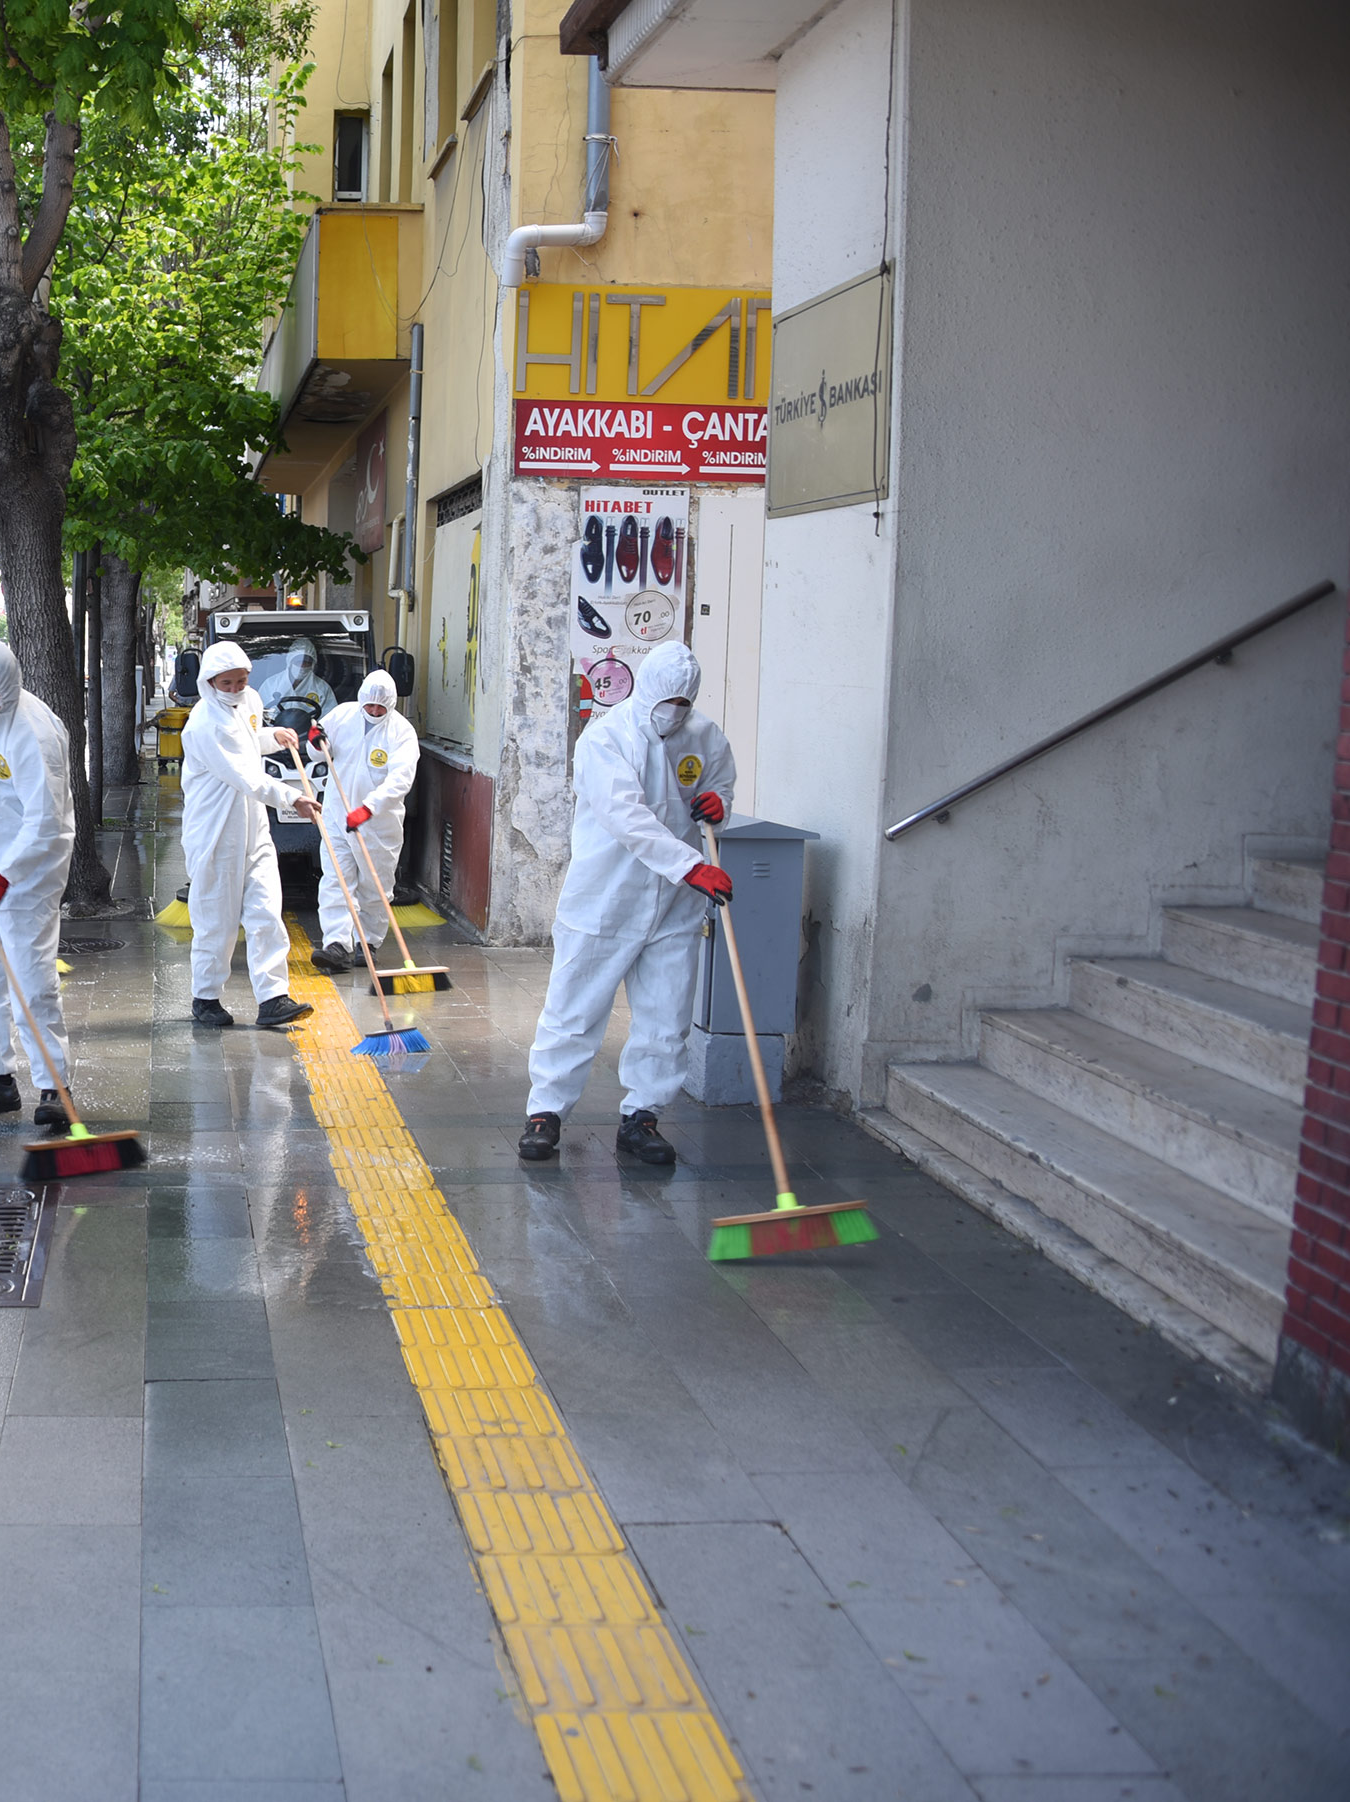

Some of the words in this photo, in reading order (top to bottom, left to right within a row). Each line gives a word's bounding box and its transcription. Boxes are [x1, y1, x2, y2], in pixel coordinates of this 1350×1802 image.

[775, 391, 816, 426] TÜRKİYE
[829, 370, 882, 408] BANKASI
[524, 407, 653, 439] AYAKKABI
[681, 411, 768, 448] ÇANTA
[642, 489, 686, 497] OUTLET
[633, 610, 652, 626] 70
[594, 676, 612, 690] 45
